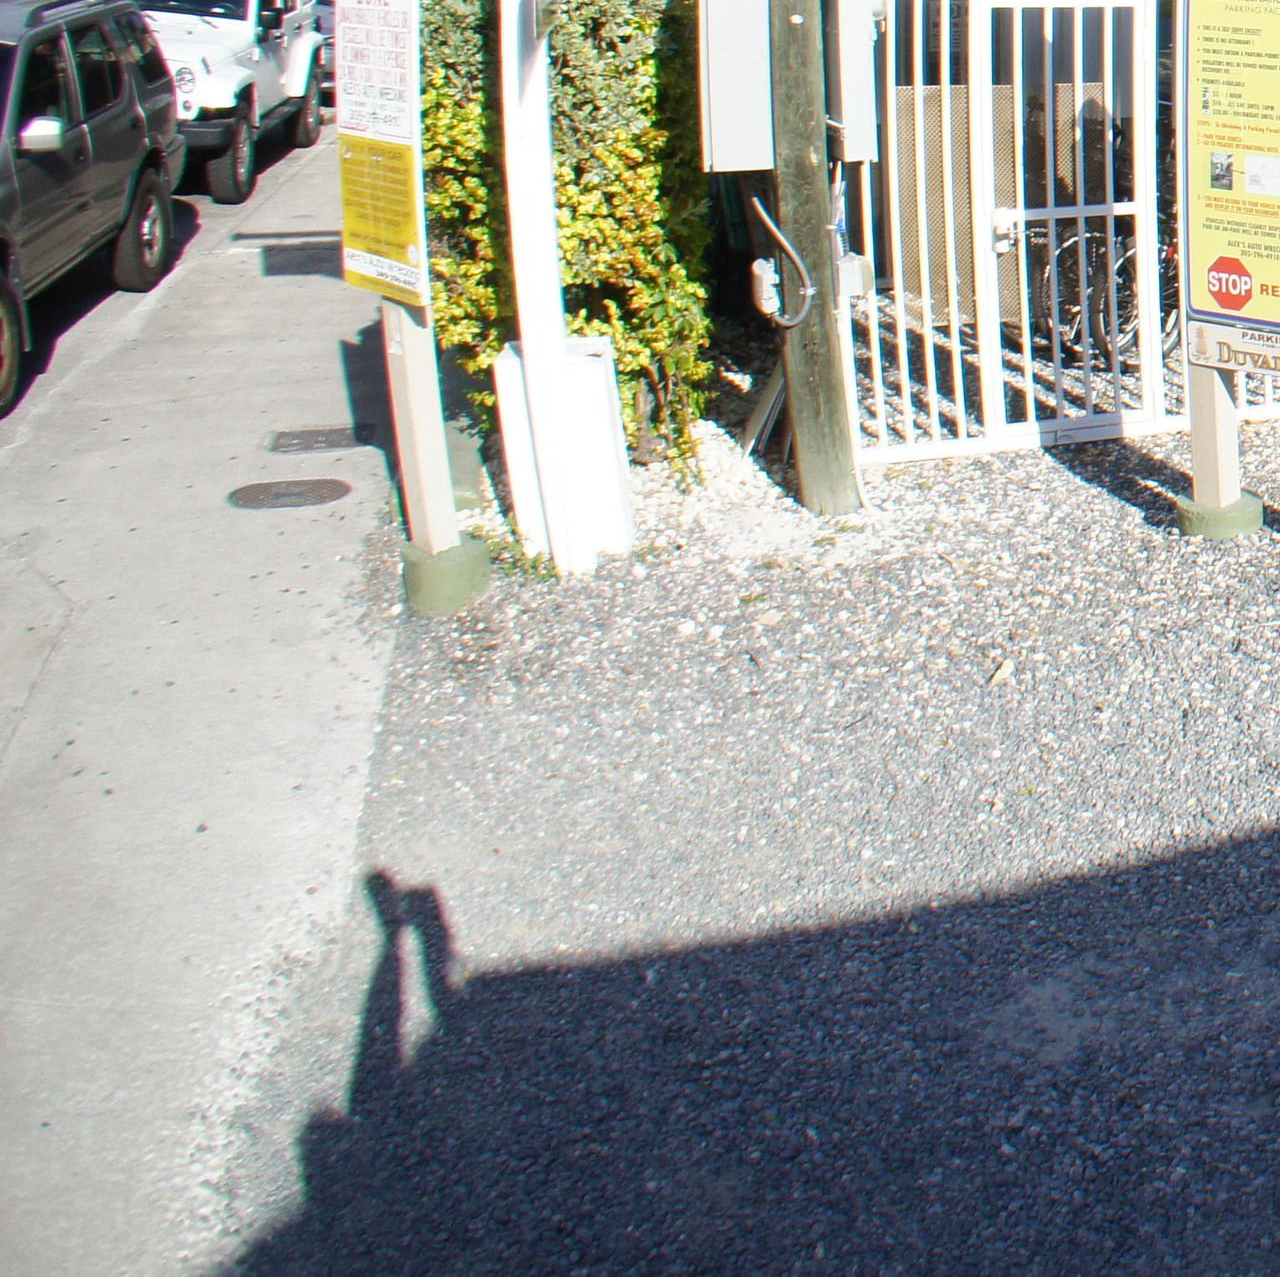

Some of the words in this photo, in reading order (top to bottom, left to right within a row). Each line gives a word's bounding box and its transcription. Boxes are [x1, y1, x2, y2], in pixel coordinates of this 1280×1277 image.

[1225, 4, 1262, 14] PARKING
[1227, 219, 1247, 228] WITHOUT
[1249, 222, 1267, 231] CLEARLY
[1228, 240, 1246, 249] ALEX'S
[1248, 242, 1262, 251] AUTO
[1208, 271, 1252, 296] STOP
